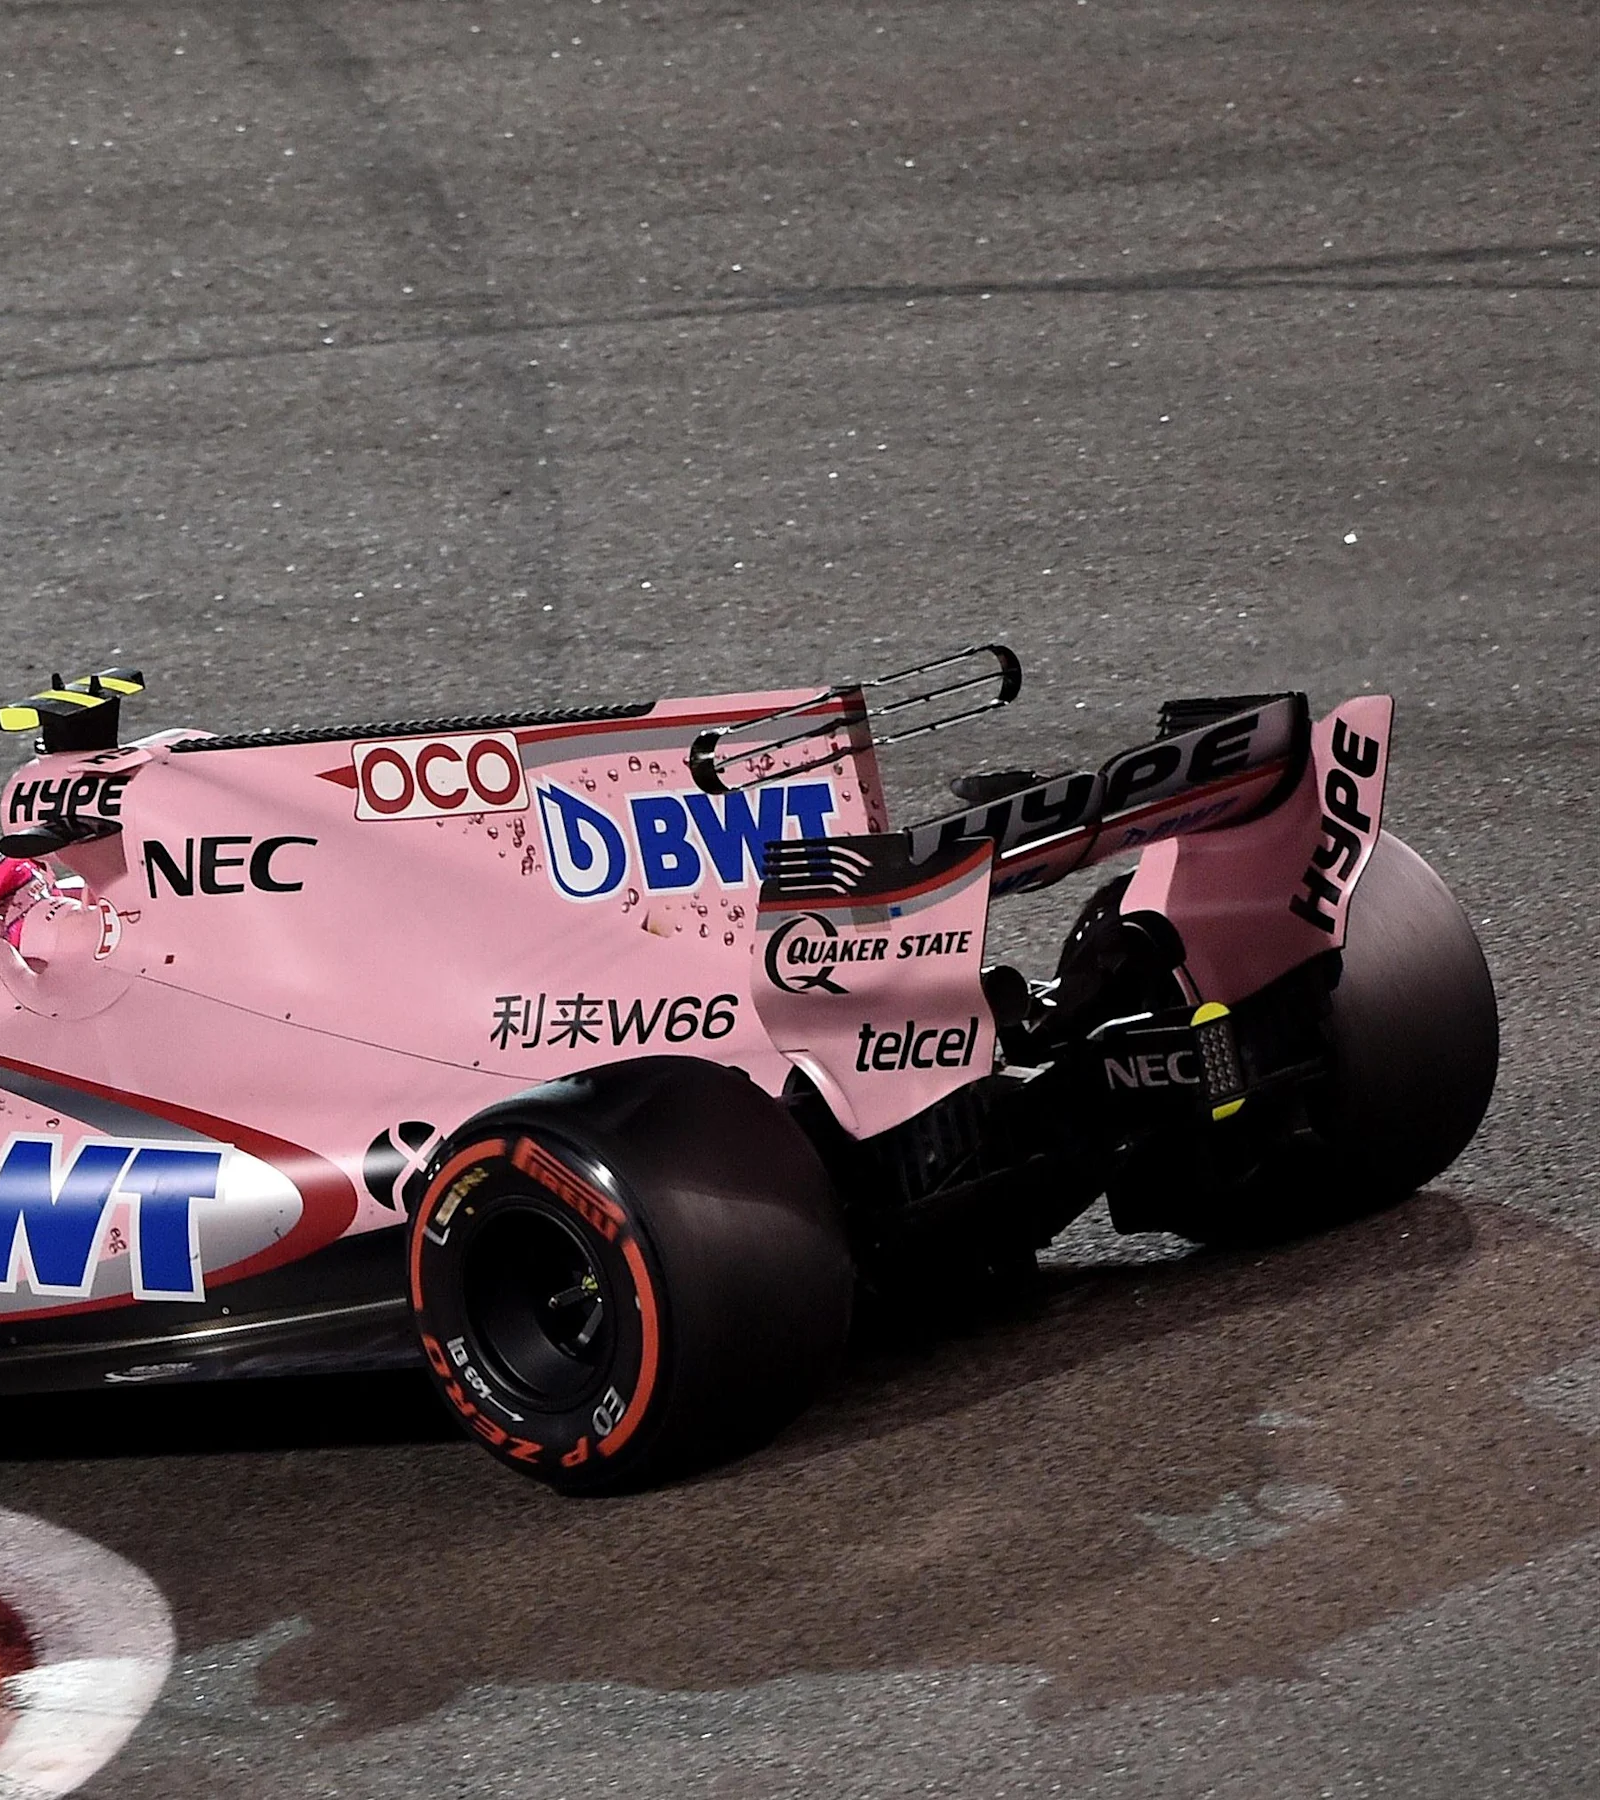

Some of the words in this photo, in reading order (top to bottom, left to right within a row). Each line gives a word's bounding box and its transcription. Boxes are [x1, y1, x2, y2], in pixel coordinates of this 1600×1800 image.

[9, 775, 132, 824] HYPE
[361, 738, 521, 815] OCO
[938, 714, 1259, 848] HYPE
[629, 783, 834, 890] BWT
[1289, 717, 1380, 934] HYPE
[145, 836, 318, 899] NEC
[786, 933, 888, 967] QUAKER
[897, 930, 973, 960] STATE
[489, 992, 740, 1051] 利来W66
[855, 1018, 979, 1073] telcel
[1106, 1050, 1200, 1090] NEC
[422, 1332, 545, 1465] ZERO
